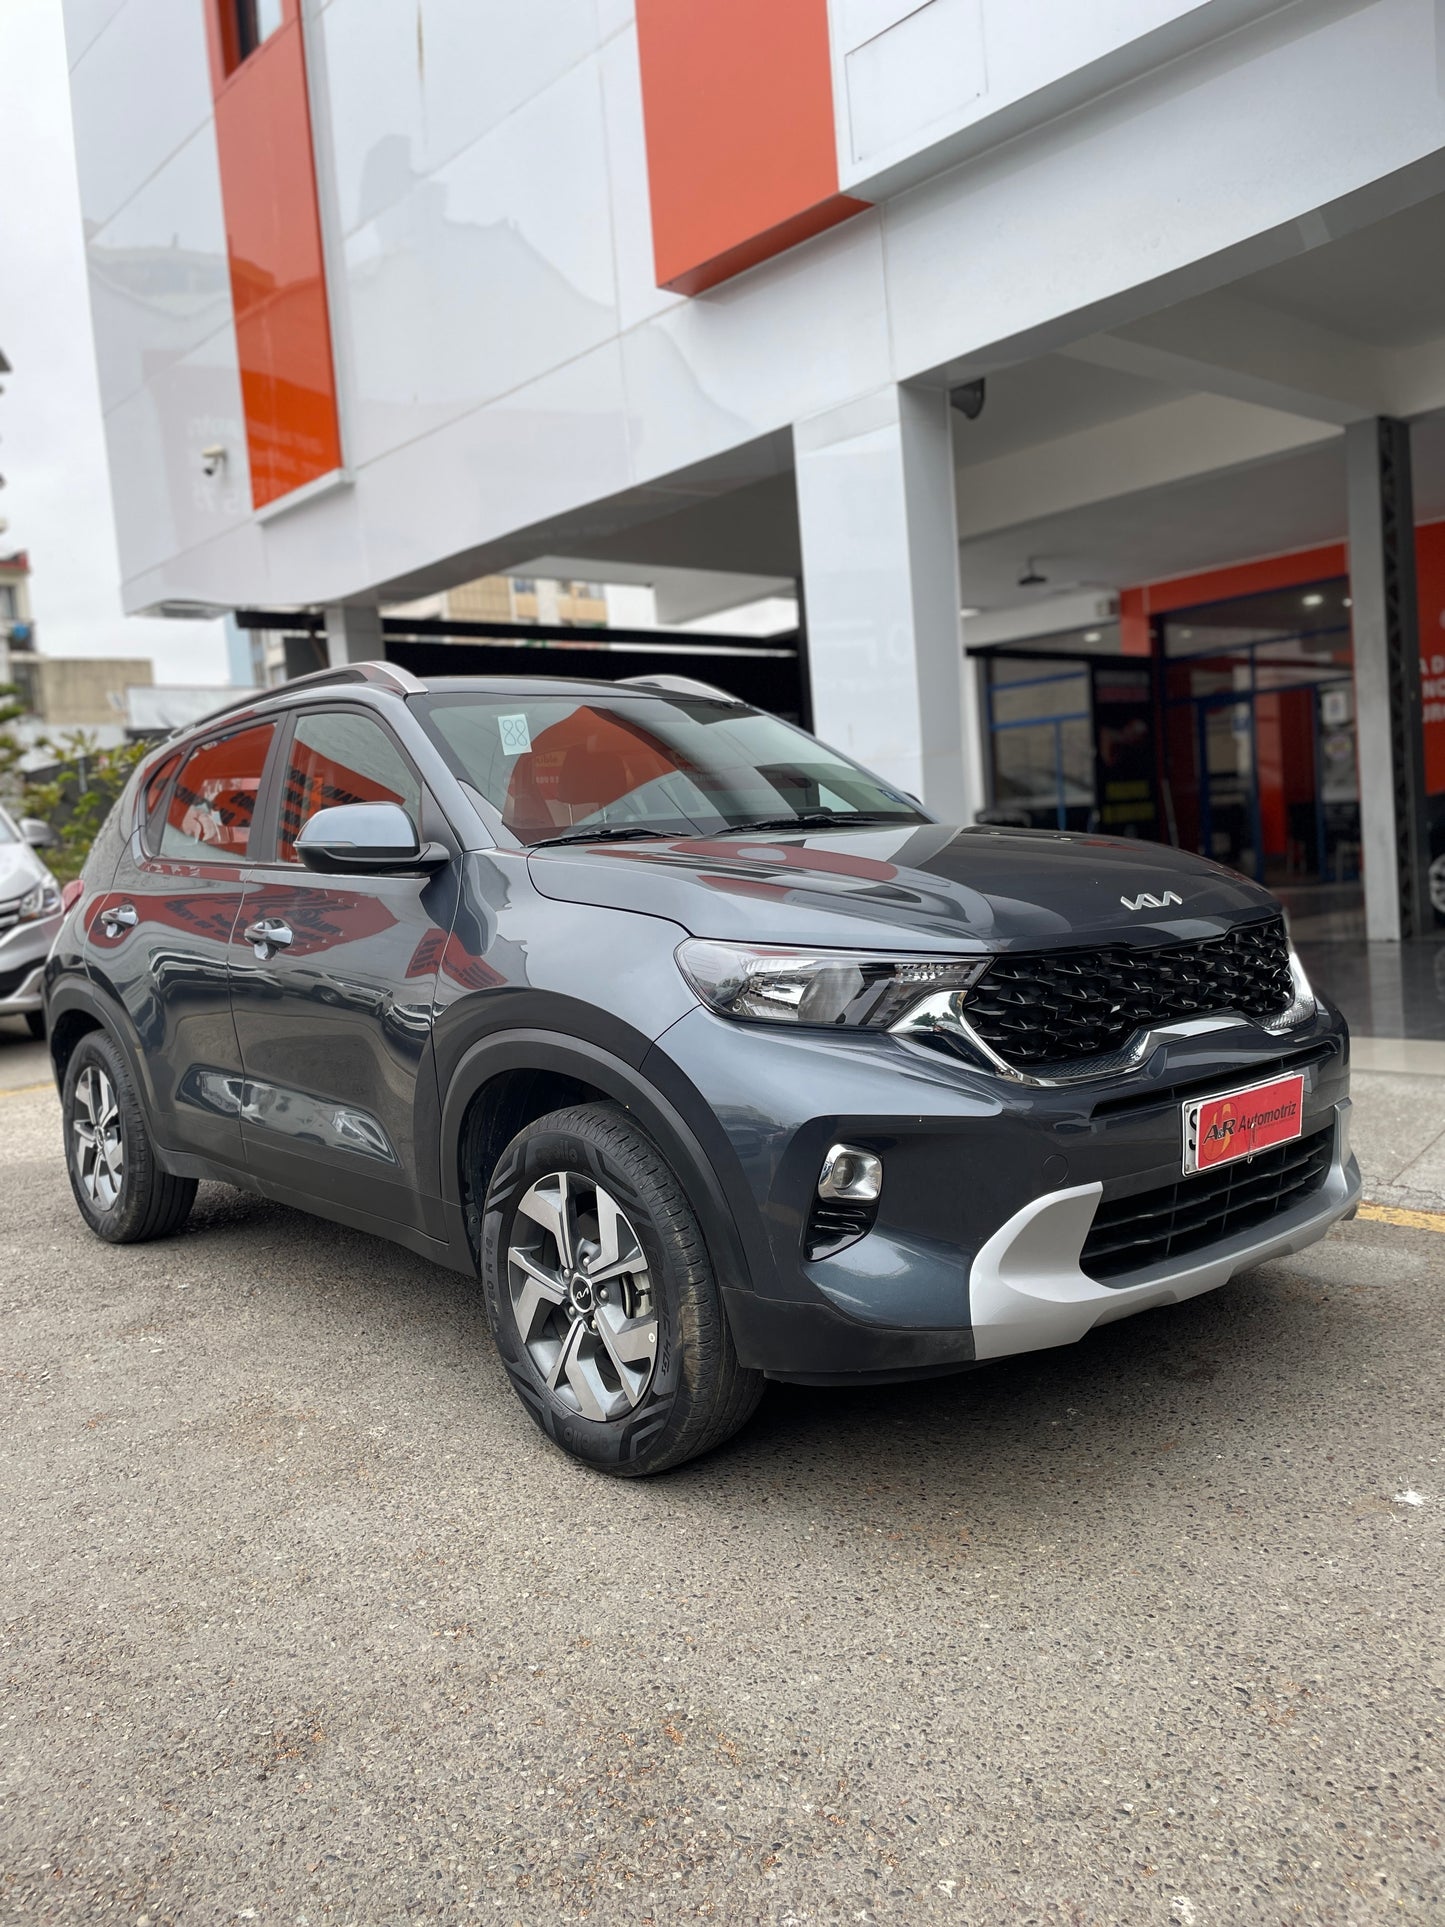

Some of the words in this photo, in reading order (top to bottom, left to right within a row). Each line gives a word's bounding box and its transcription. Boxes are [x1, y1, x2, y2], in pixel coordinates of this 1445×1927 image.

[502, 719, 528, 747] 88
[1120, 890, 1183, 911] KIA
[1203, 1118, 1236, 1145] A&R
[1238, 1101, 1297, 1132] Automotriz
